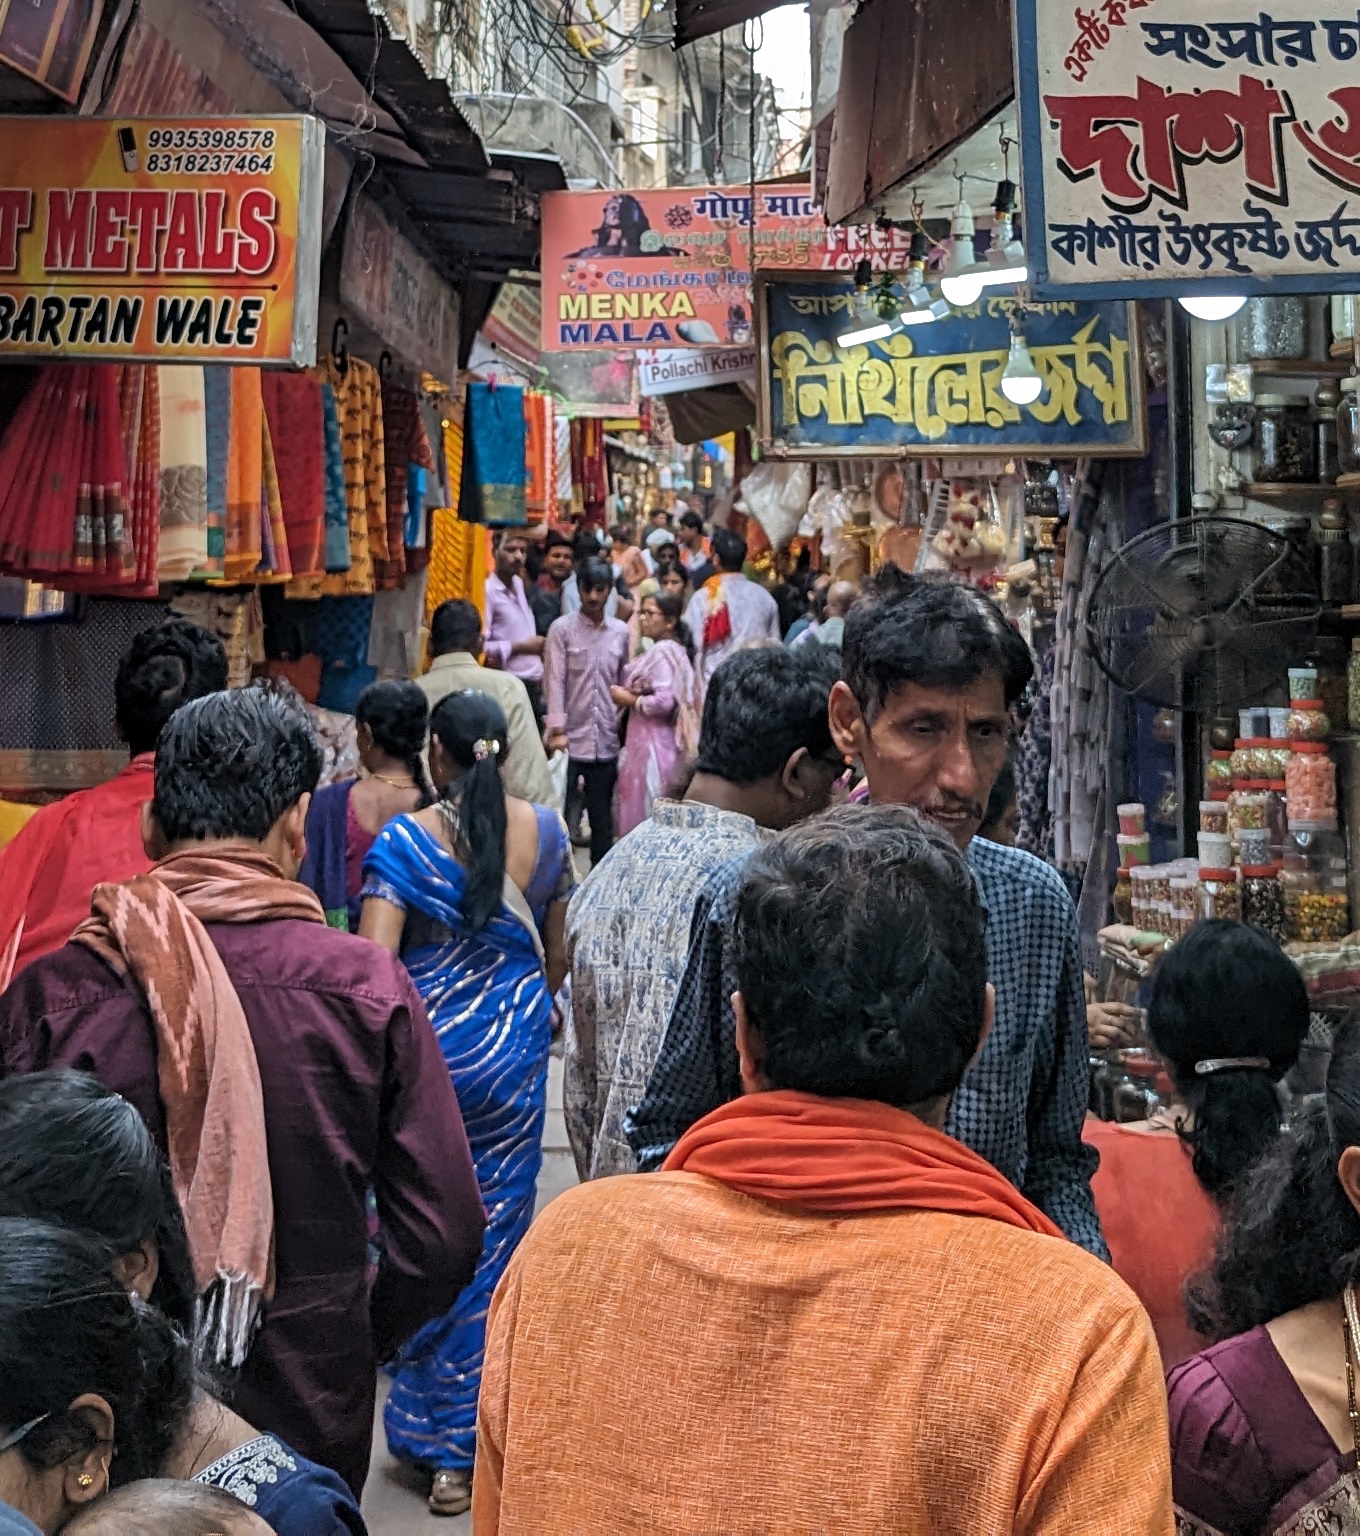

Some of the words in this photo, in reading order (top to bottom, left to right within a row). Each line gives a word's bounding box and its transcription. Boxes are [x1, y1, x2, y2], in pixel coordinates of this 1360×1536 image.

[1063, 7, 1110, 82] একটি
[1140, 11, 1316, 68] সংসার
[146, 153, 275, 176] 8318237464
[147, 128, 276, 151] 9935398578
[1043, 74, 1296, 212] দাশ
[43, 188, 277, 275] METALS
[1048, 215, 1160, 271] কাশীর
[156, 296, 263, 348] WALE
[558, 291, 697, 321] MENKA
[560, 322, 673, 345] MALA
[651, 358, 708, 381] Pollachi
